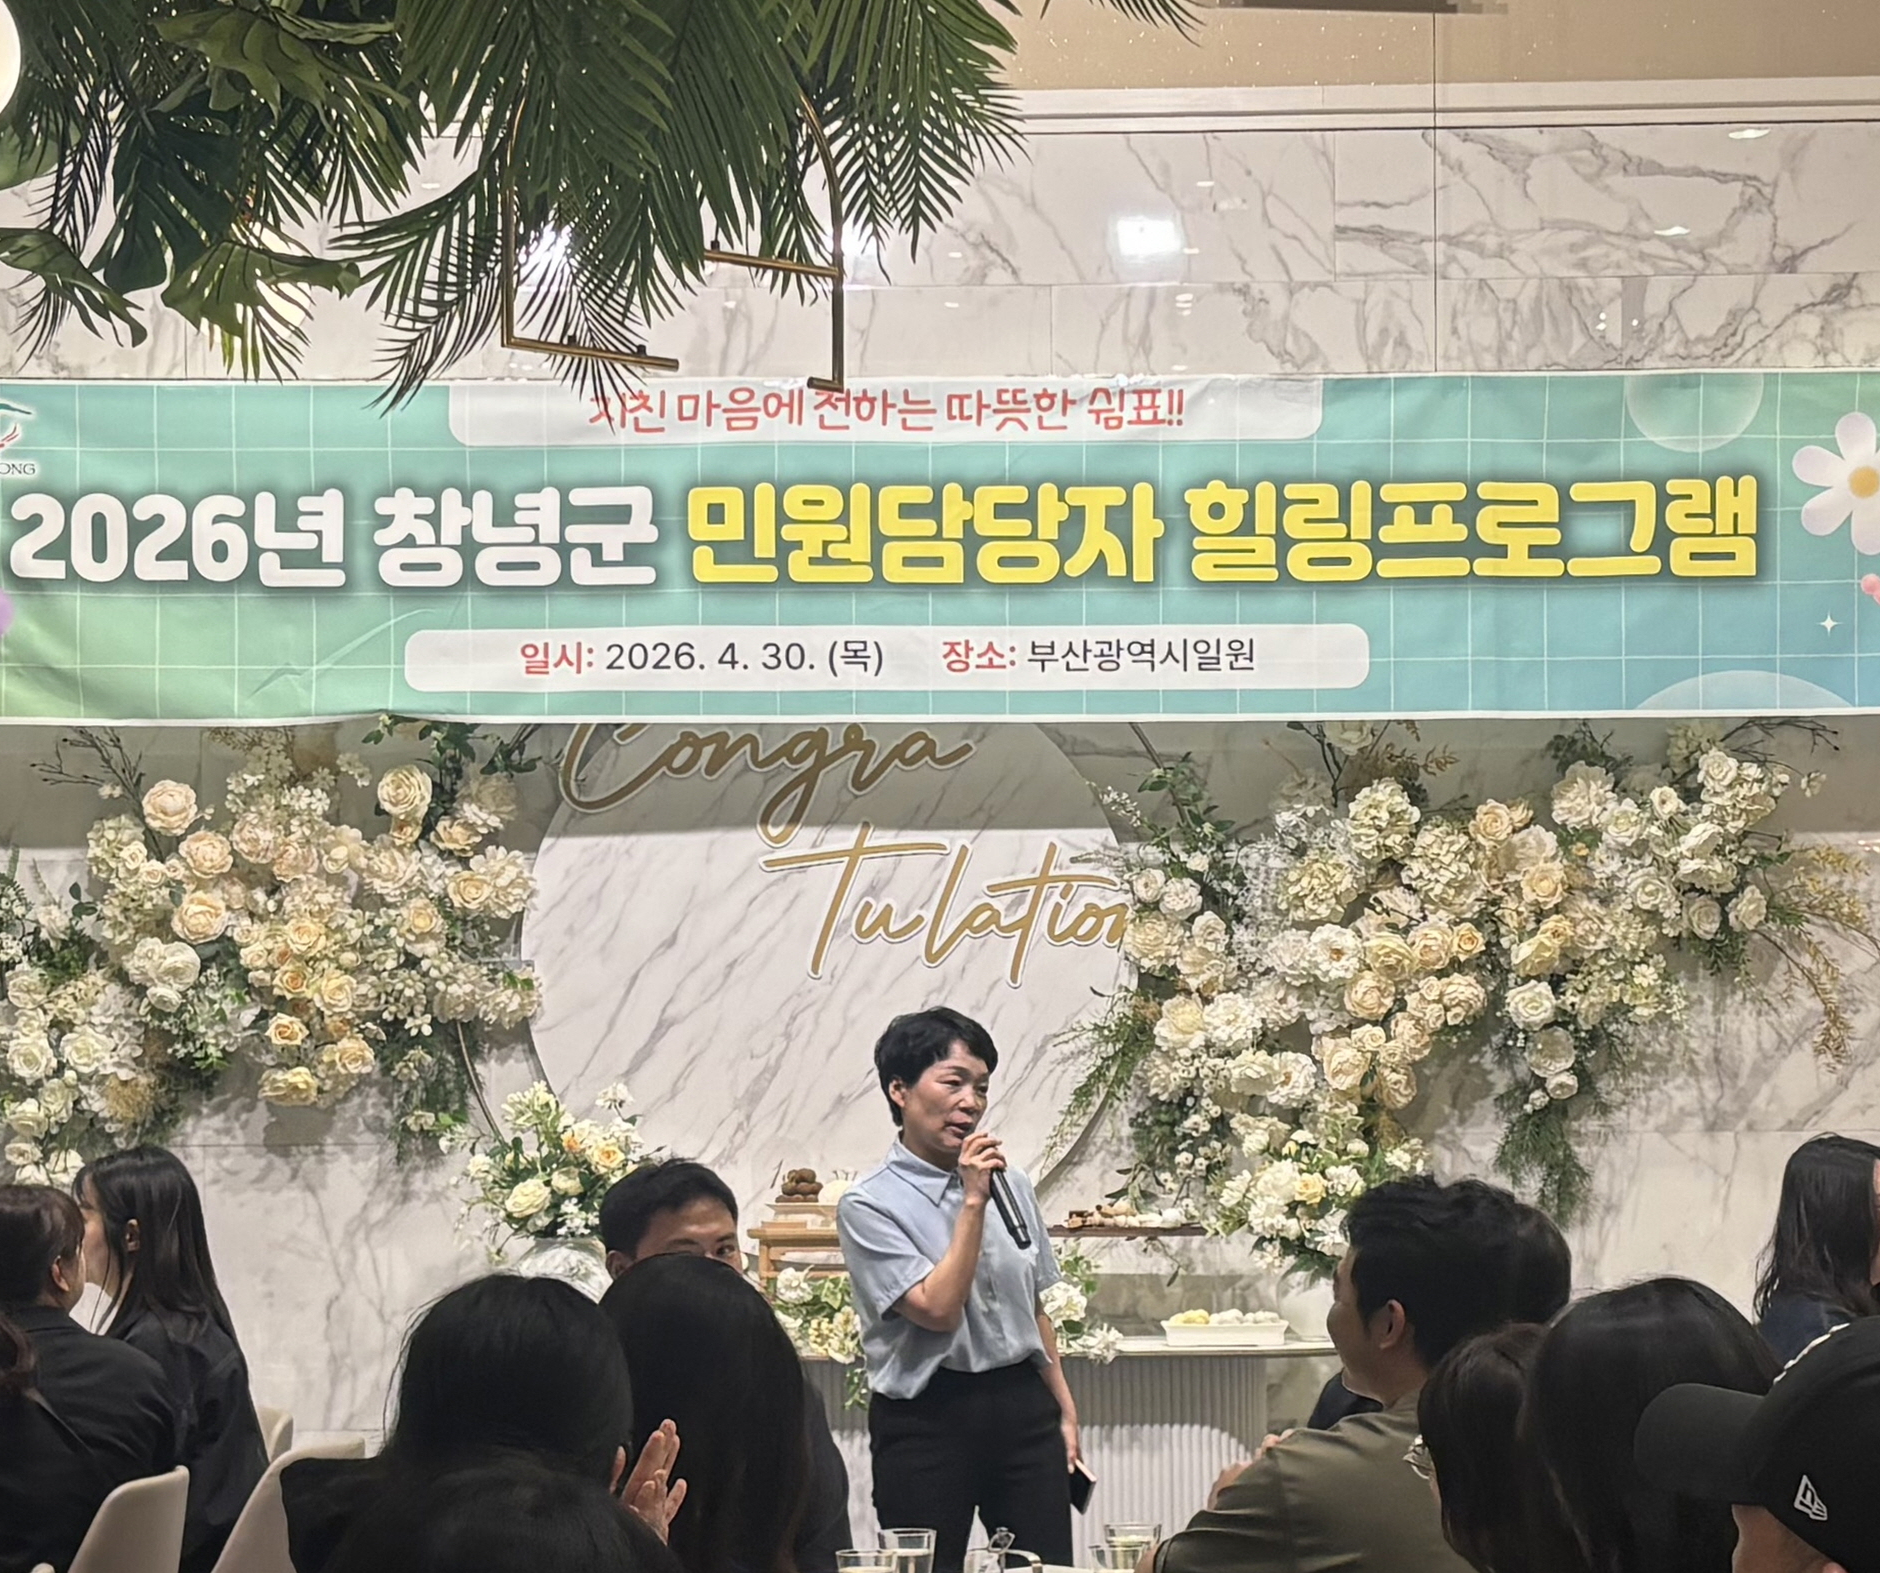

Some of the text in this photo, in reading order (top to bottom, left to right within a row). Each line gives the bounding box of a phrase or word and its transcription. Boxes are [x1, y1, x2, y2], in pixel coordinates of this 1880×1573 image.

[676, 387, 804, 432] 마음에
[813, 387, 938, 432] 전하는
[945, 387, 1077, 432] 따뜻한
[1087, 387, 1185, 431] 쉼표!!
[9, 475, 1759, 588] 2026년 창녕군 민원담당자 힐링프로그램
[519, 639, 884, 677] 일시: 2026. 4. 30. (목)
[941, 637, 1255, 673] 장소: 부산광역시일원
